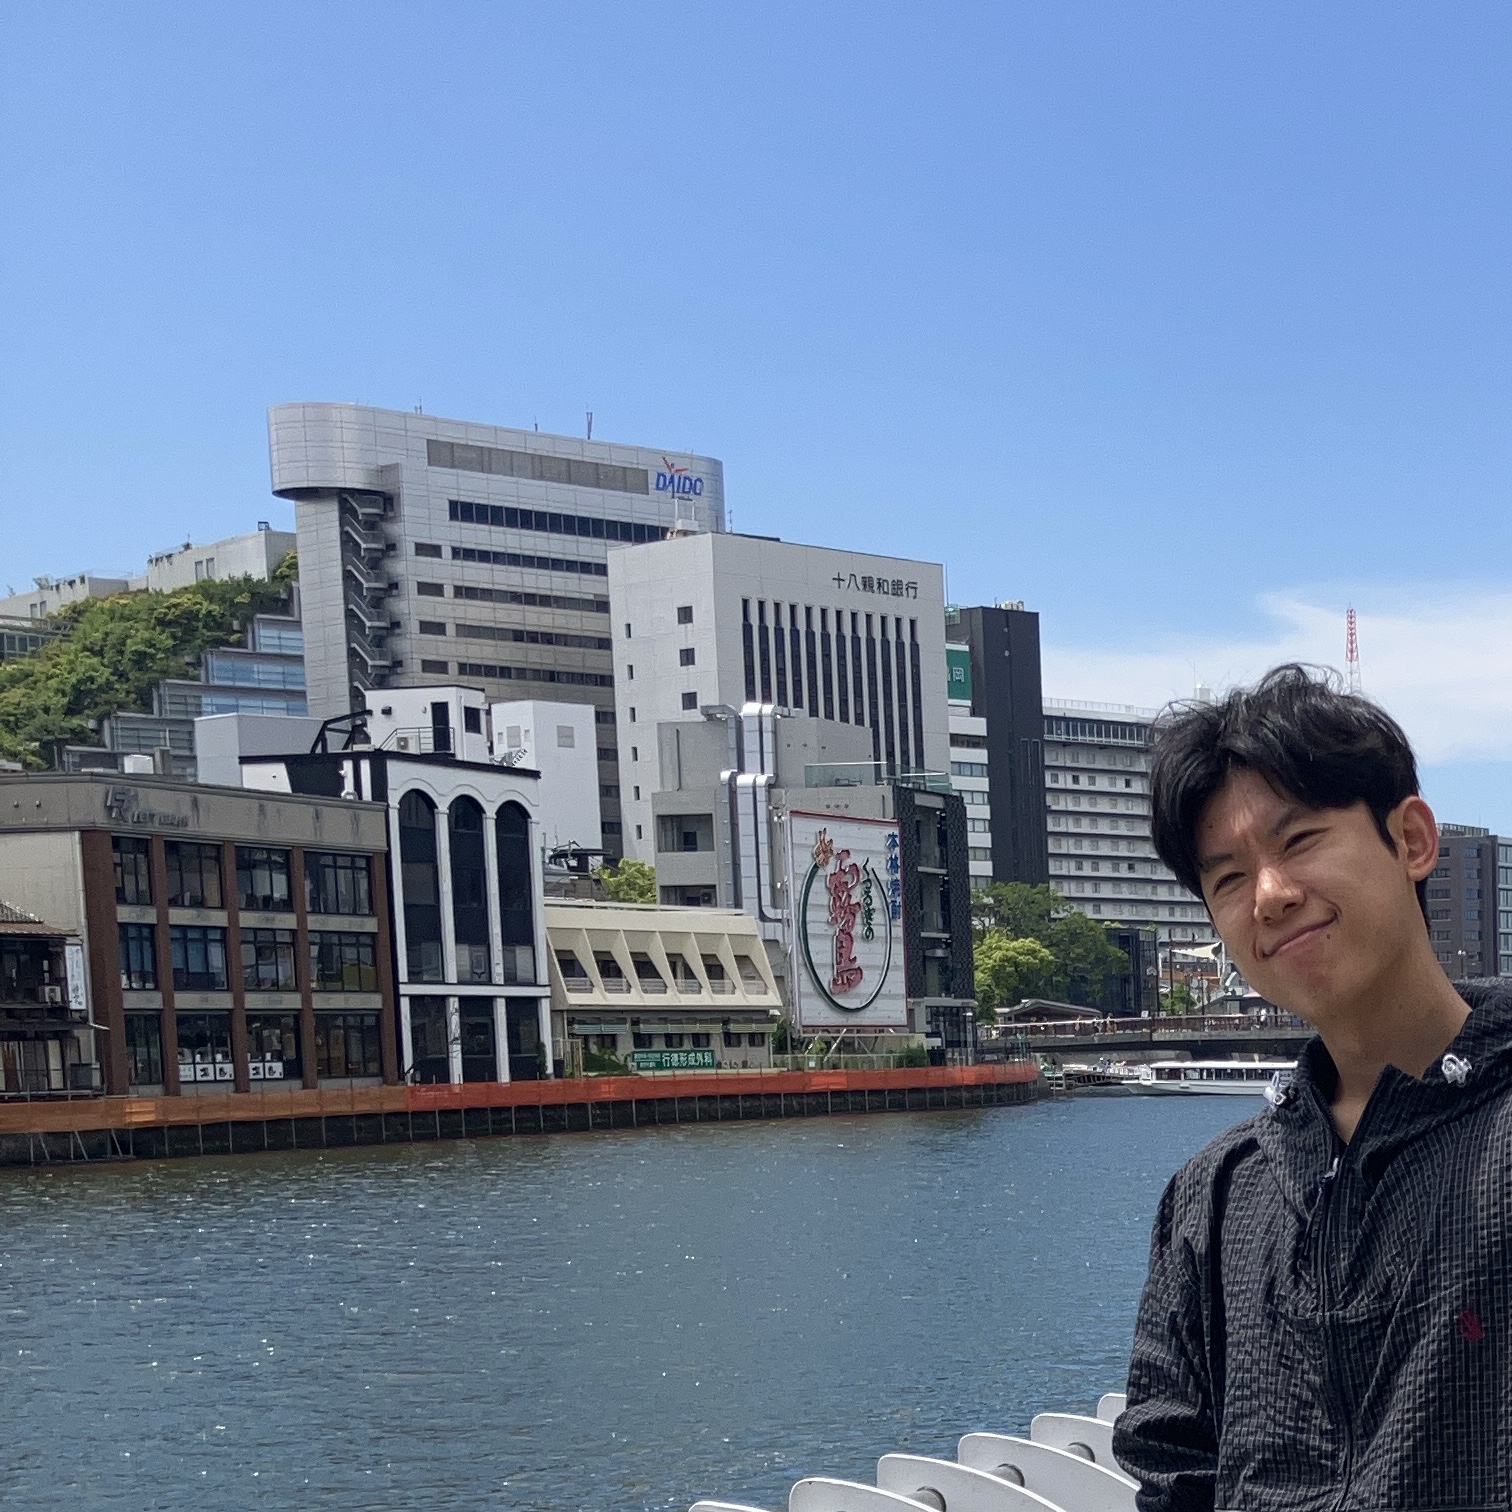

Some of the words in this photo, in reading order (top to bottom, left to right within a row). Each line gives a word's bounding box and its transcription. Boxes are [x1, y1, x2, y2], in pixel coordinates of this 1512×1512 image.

[655, 471, 705, 499] DAIDO
[832, 571, 919, 600] 十八親和銀行
